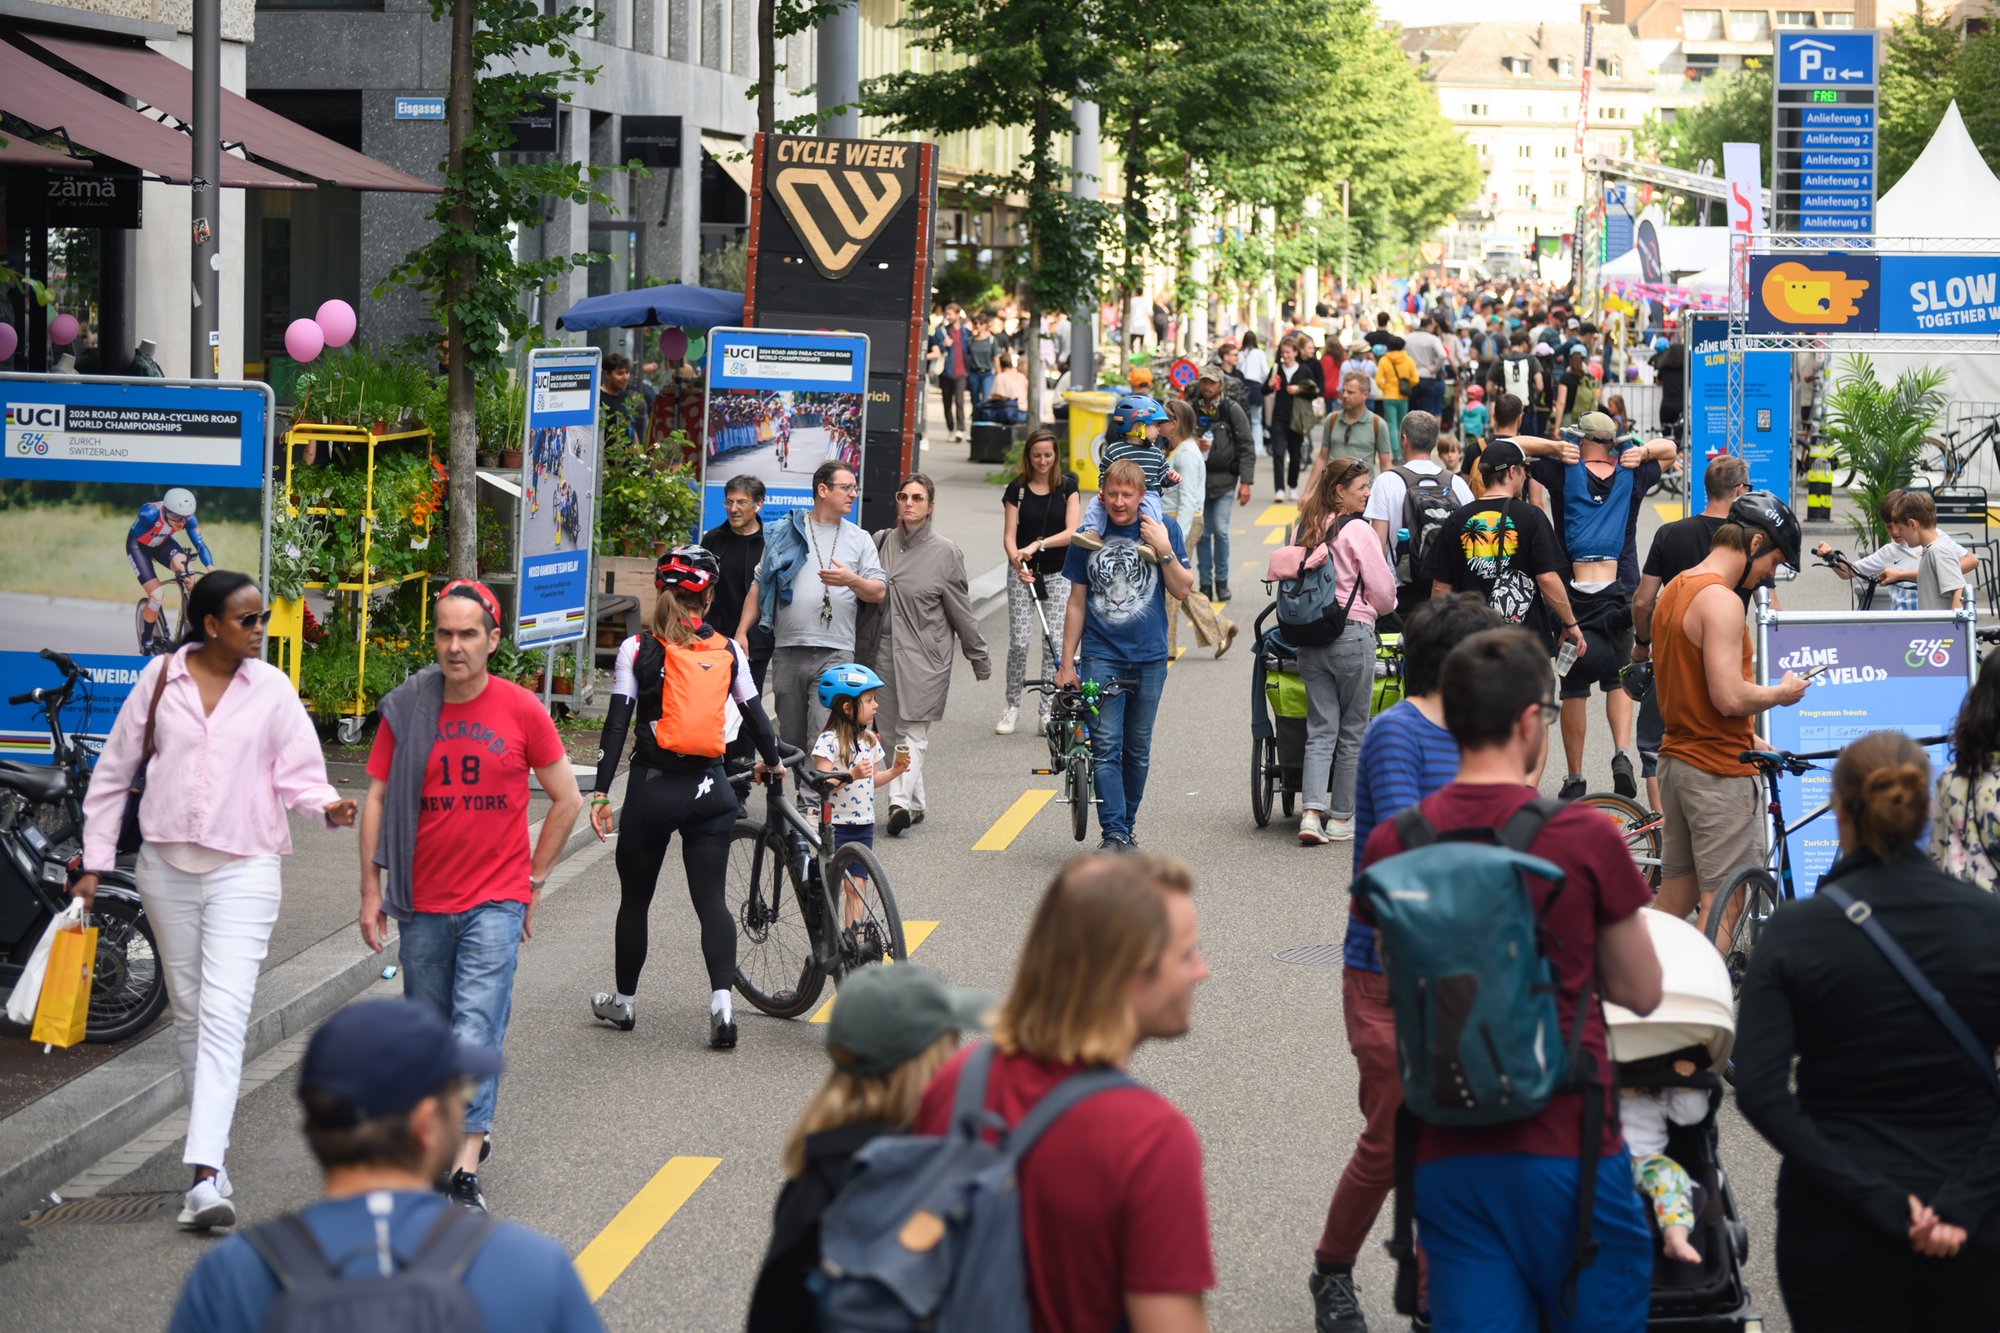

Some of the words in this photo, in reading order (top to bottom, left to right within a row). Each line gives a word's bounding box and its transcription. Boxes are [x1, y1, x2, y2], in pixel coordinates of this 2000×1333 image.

[1814, 90, 1836, 102] FREI
[398, 102, 442, 116] Eisgasse
[1807, 113, 1861, 126] Anlieferung
[1864, 114, 1868, 123] 1
[1806, 134, 1860, 146] Anlieferung
[1862, 134, 1868, 144] 2
[777, 140, 840, 164] CYCLE
[846, 144, 908, 168] WEEK
[1806, 154, 1860, 167] Anlieferung
[1862, 155, 1868, 165] 3
[48, 176, 116, 198] zämä
[1805, 176, 1859, 188] Anlieferung
[1862, 176, 1868, 186] 4
[1804, 196, 1858, 209] Anlieferung
[1862, 197, 1867, 206] 5
[1804, 216, 1858, 230] Anlieferung
[1861, 218, 1867, 227] 6
[1910, 272, 1996, 312] SLOW
[1916, 308, 1986, 329] TOGETHER
[730, 348, 754, 359] UCI
[1704, 353, 1725, 366] SLOW
[538, 376, 549, 388] UCI
[867, 391, 890, 402] rich
[16, 407, 60, 426] UCI
[69, 410, 90, 419] 2024
[92, 411, 118, 420] ROAD
[120, 412, 140, 420] AND
[142, 412, 208, 422] PARA-CYCLING
[211, 414, 238, 424] ROAD
[69, 420, 102, 429] WORLD
[105, 421, 182, 432] CHAMPIONSHIPS
[69, 437, 101, 446] ZURICH
[69, 448, 128, 457] SWITZERLAND
[1765, 508, 1784, 527] city
[1778, 646, 1839, 669] «ZÄME
[1828, 666, 1888, 686] VELO»
[1799, 709, 1842, 718] Programm
[440, 755, 480, 785] 18
[420, 796, 455, 812] NEW
[462, 794, 508, 810] YORK
